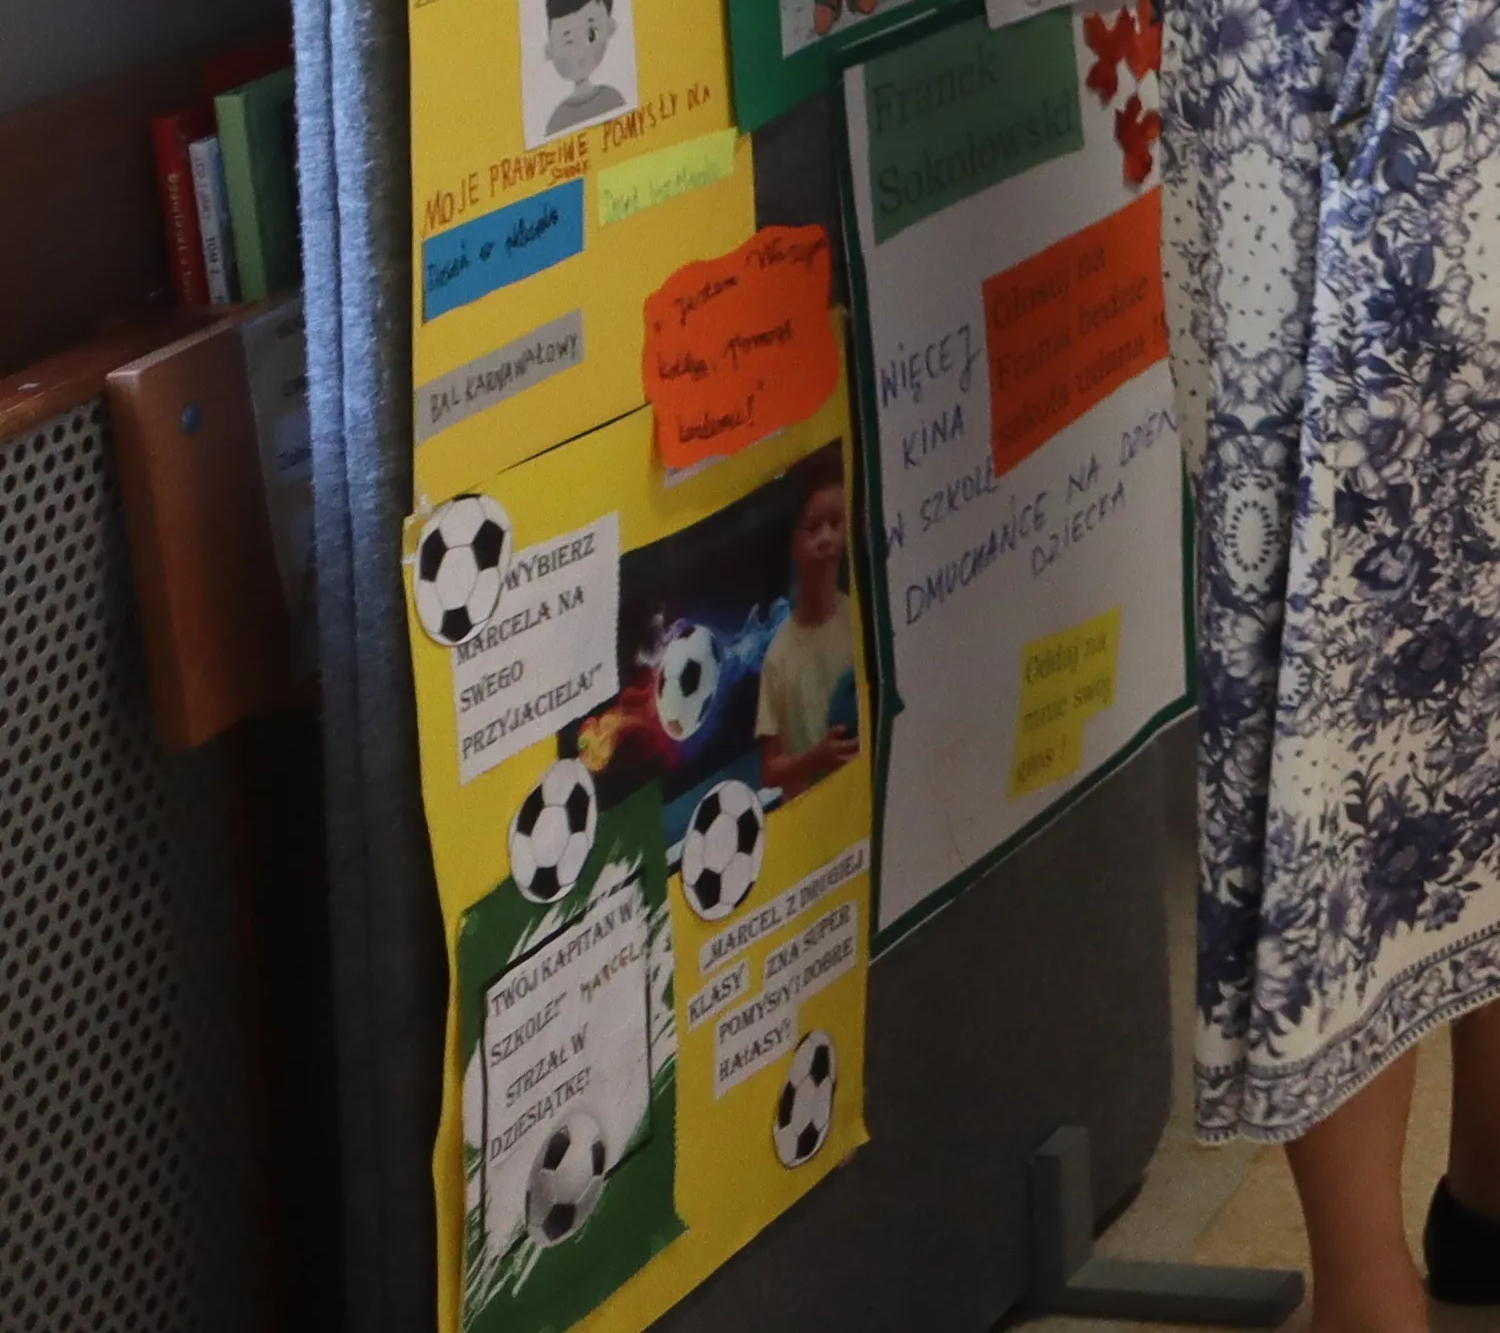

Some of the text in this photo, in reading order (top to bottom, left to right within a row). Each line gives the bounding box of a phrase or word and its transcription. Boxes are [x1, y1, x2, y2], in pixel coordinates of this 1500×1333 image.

[872, 43, 998, 133] Franek
[422, 172, 480, 239] MOJE
[601, 94, 679, 154] POMYSŁY
[429, 334, 579, 424] BAL KARNAWAŁOWY
[880, 323, 981, 409] WIĘCEJ
[902, 403, 964, 471] KINA
[1065, 453, 1100, 506] NA
[455, 585, 585, 666] MARCELA NA
[459, 658, 525, 714] SWEGO
[490, 900, 636, 1017] TWÓJ KAPITAN W
[688, 962, 746, 1025] KLASY
[766, 942, 800, 980] ZNA
[505, 1022, 590, 1109] STRZAŁ W
